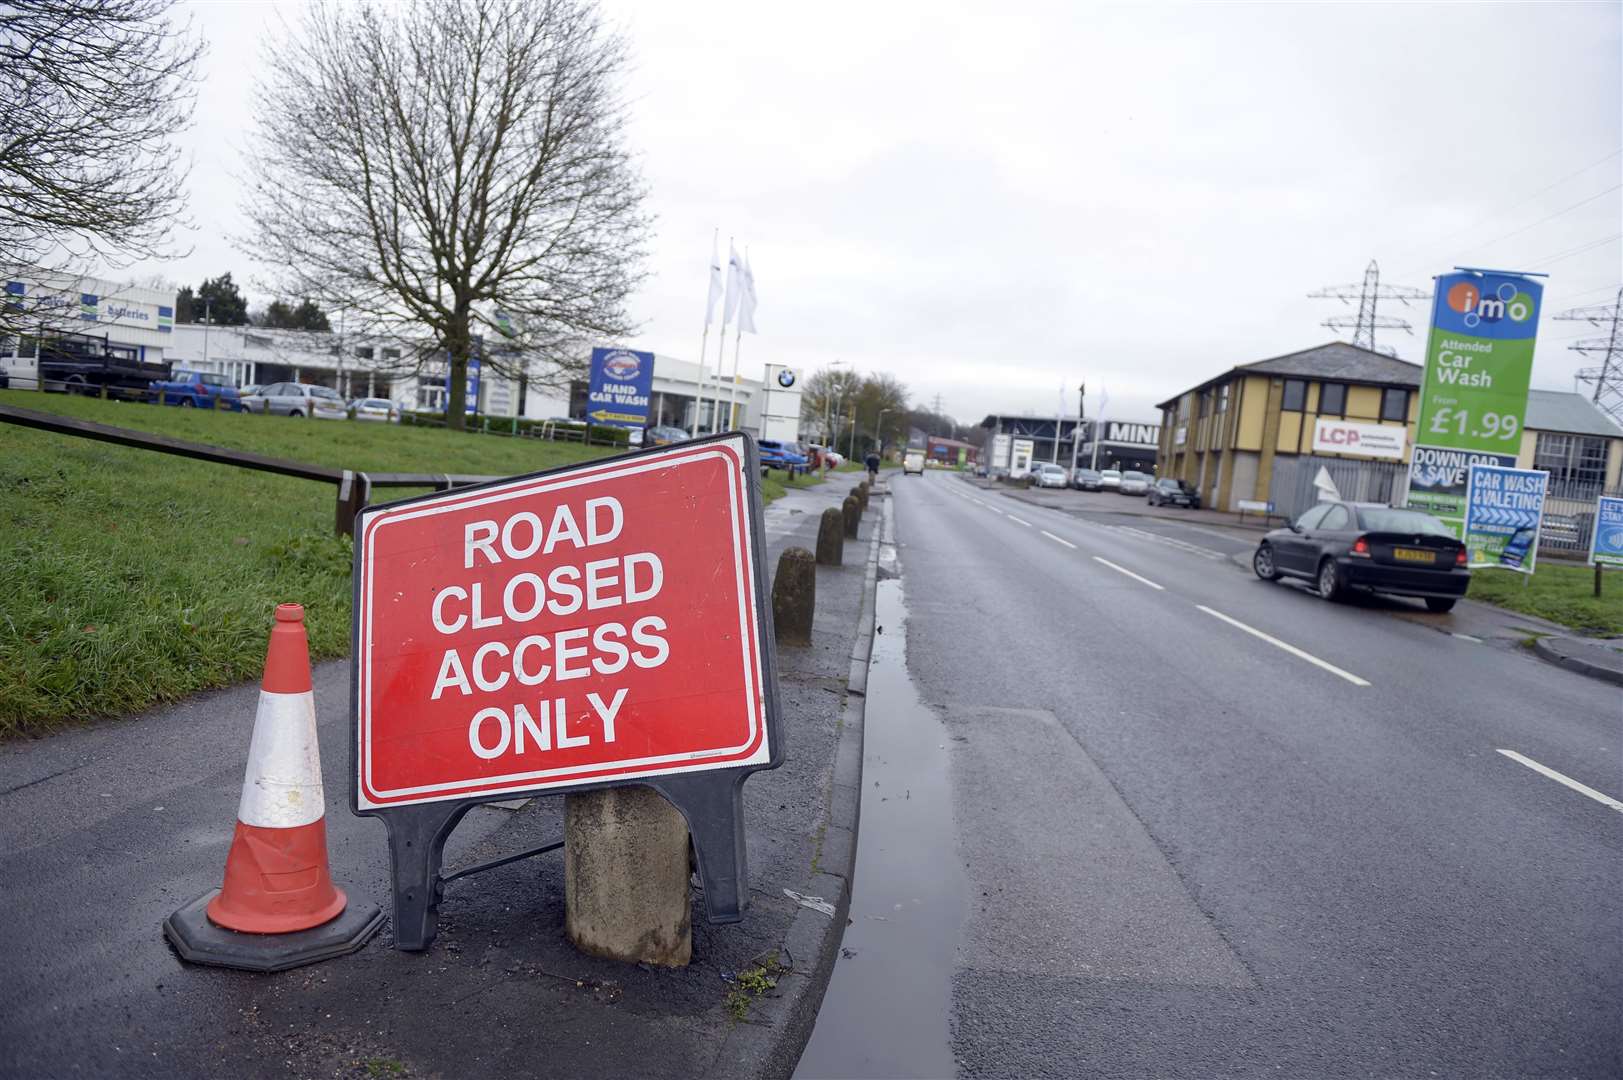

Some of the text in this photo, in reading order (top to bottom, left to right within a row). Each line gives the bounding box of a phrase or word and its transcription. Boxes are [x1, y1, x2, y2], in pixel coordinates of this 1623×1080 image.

[107, 305, 149, 321] batteries
[1464, 292, 1528, 321] imo
[1440, 339, 1493, 353] Attended
[1438, 350, 1473, 368] Car
[1437, 367, 1492, 388] Wash
[590, 392, 649, 406] CAR WASH
[602, 383, 637, 395] HAND
[1110, 422, 1160, 445] MINI
[1430, 407, 1518, 441] £1.99
[1319, 426, 1360, 446] LCP
[1411, 464, 1465, 484] & SAVE
[1474, 471, 1545, 494] CAR WASH
[464, 496, 624, 569] ROAD
[432, 551, 664, 635] CLOSED
[430, 616, 670, 700] ACCESS
[468, 687, 629, 760] ONLY
